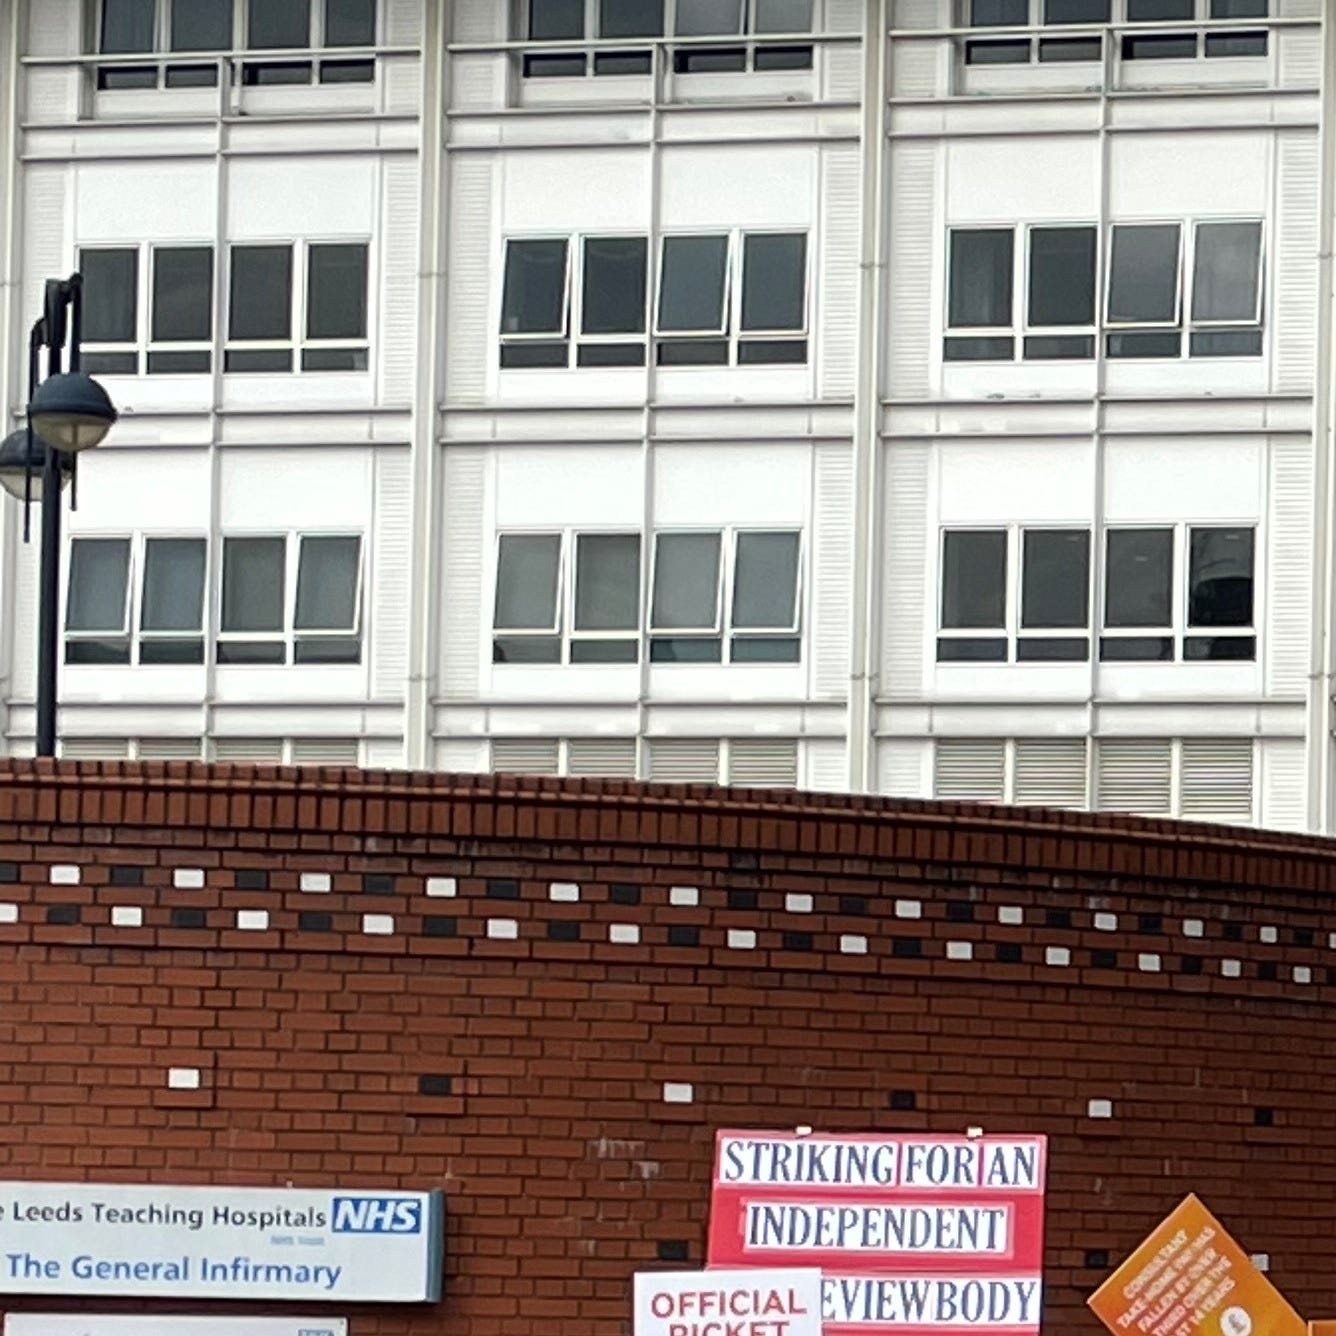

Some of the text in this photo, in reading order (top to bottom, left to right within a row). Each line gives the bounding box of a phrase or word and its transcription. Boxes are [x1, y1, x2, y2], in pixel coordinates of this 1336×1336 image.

[724, 1140, 1036, 1186] STRIKING FOR AN
[13, 1202, 83, 1222] Leeds
[93, 1203, 204, 1230] Teaching
[212, 1205, 327, 1230] Hospitals
[335, 1199, 419, 1232] NHS
[748, 1204, 1006, 1249] INDEPENDENT
[6, 1253, 342, 1289] The General Infirmary
[650, 1289, 807, 1319] OFFICIAL
[821, 1279, 1037, 1322] EVIEW BODY
